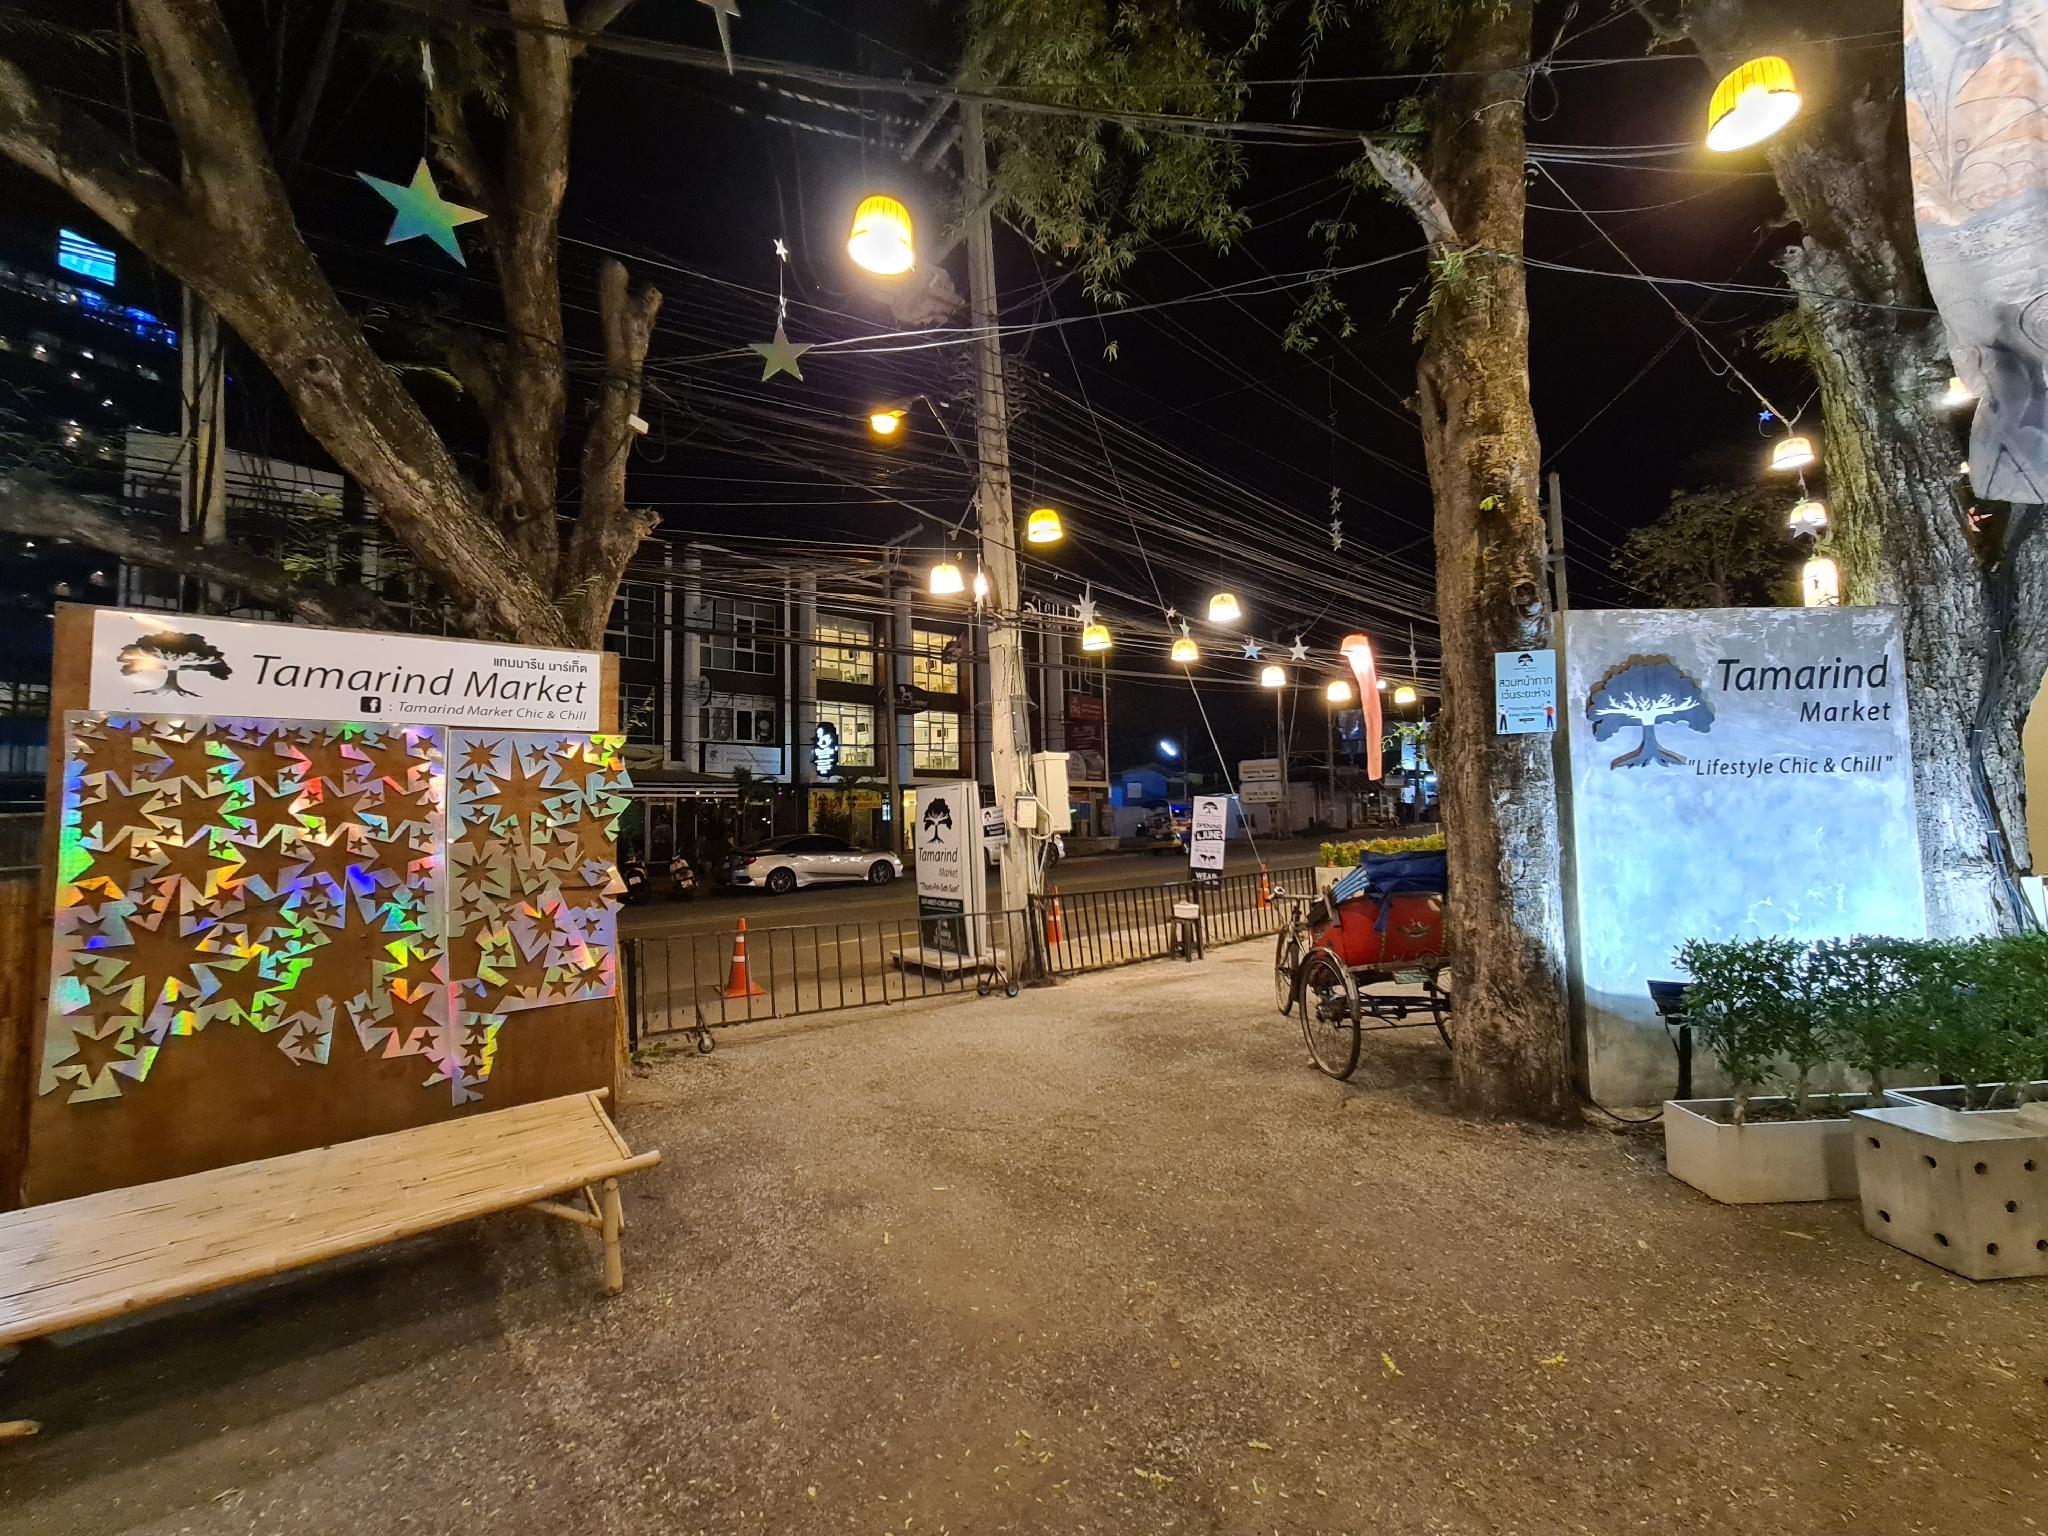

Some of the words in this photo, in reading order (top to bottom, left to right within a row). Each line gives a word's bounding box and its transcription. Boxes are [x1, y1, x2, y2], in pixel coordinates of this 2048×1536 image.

[252, 654, 454, 696] Tamarind
[463, 670, 587, 704] Market
[1717, 654, 1889, 692] Tamarind
[398, 701, 465, 715] Tamarind
[467, 705, 513, 718] Market
[516, 707, 543, 719] Chic
[546, 710, 556, 720] &
[559, 709, 587, 721] Chill
[1800, 700, 1891, 723] Market
[1688, 758, 1774, 779] "Lifestyle
[1779, 756, 1819, 774] Chic
[1823, 757, 1836, 773] &
[918, 847, 958, 863] Tamarind
